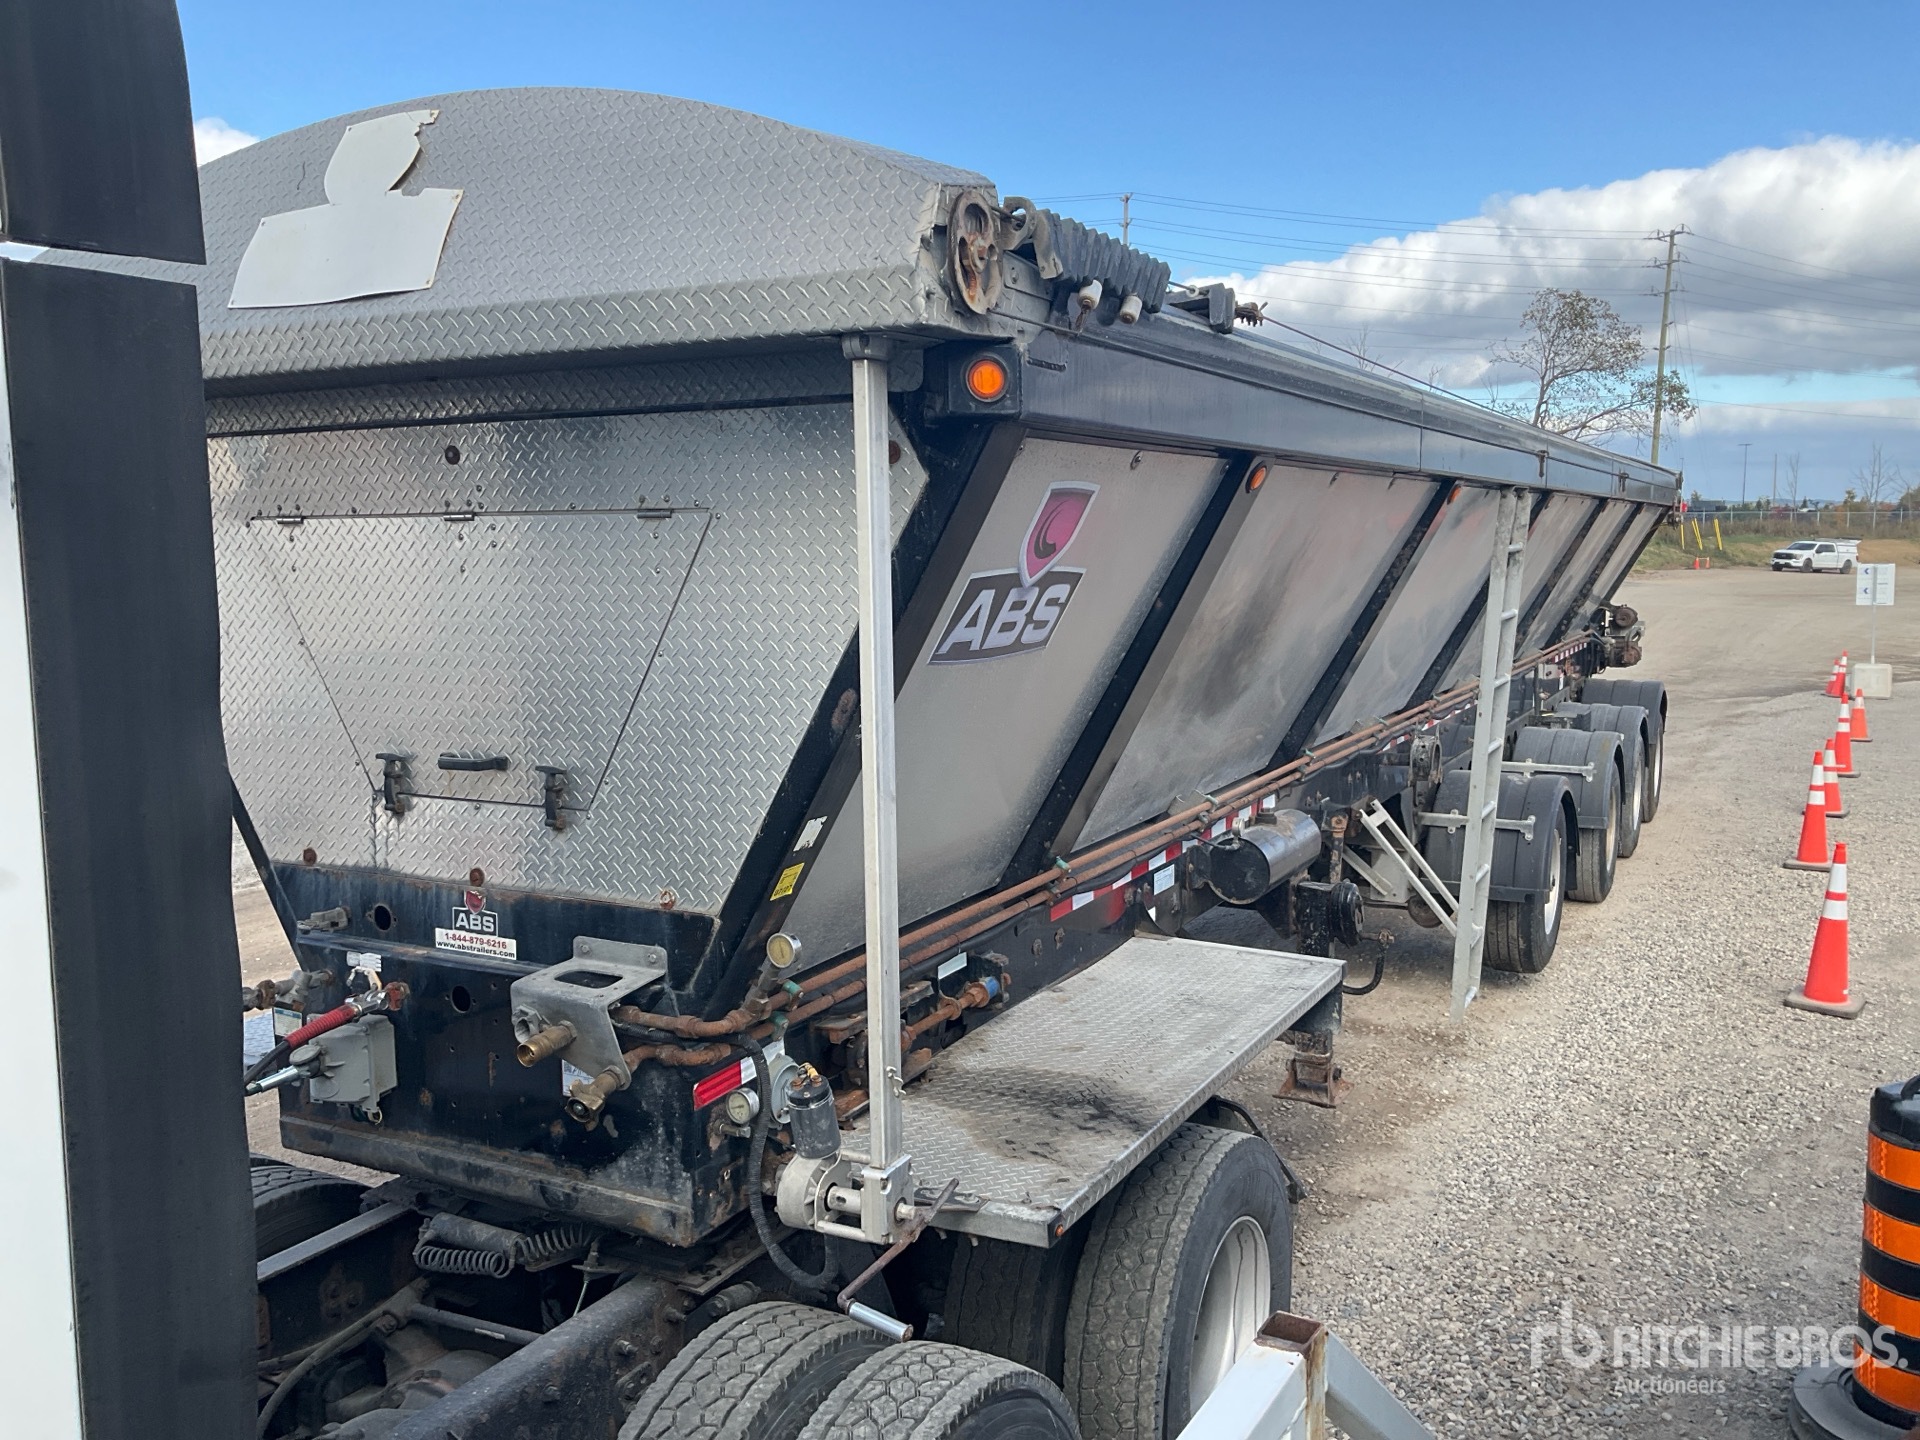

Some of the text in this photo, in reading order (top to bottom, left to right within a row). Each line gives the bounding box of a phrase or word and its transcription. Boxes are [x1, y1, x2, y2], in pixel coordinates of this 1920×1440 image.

[936, 583, 1071, 654] ABS
[455, 912, 494, 932] ABS
[437, 941, 515, 957] www.abstrailers.com
[445, 932, 507, 949] 1-844-879-6216
